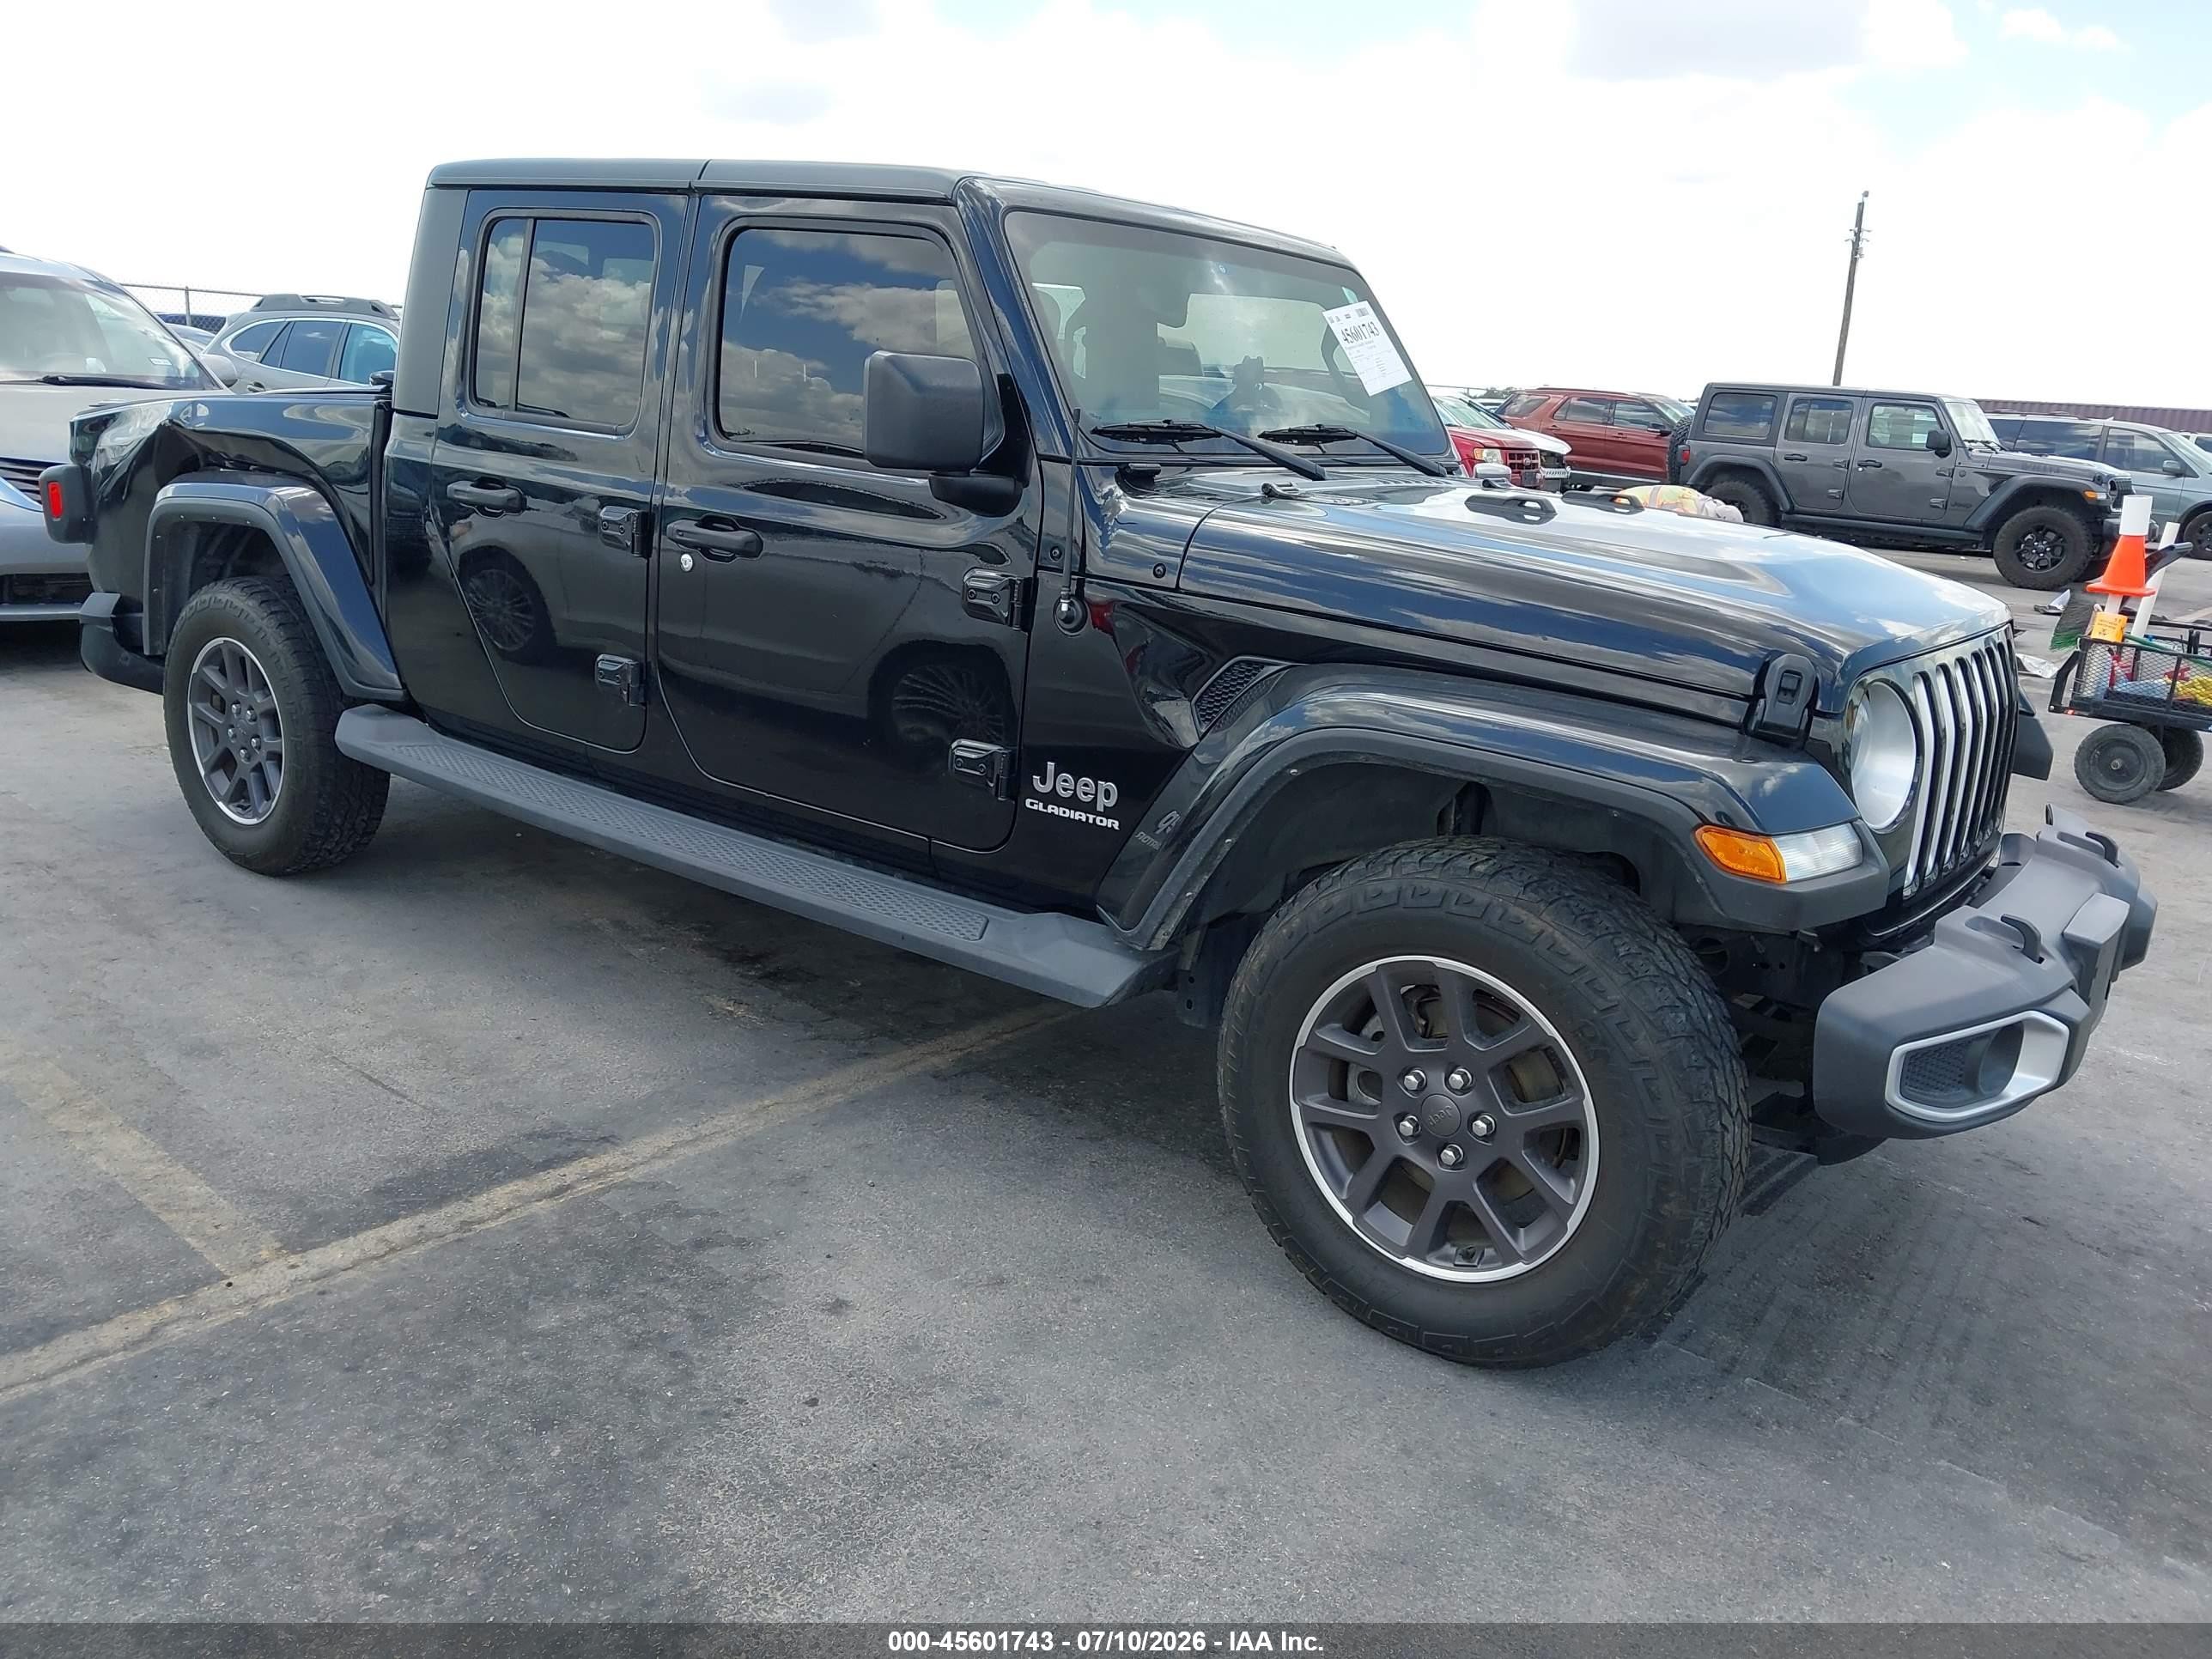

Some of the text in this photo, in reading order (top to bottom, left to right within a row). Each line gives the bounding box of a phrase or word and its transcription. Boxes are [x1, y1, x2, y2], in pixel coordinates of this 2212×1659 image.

[1341, 321, 1379, 343] 45601743
[1032, 761, 1118, 812] Jeep
[1025, 798, 1120, 830] GLADIATOR
